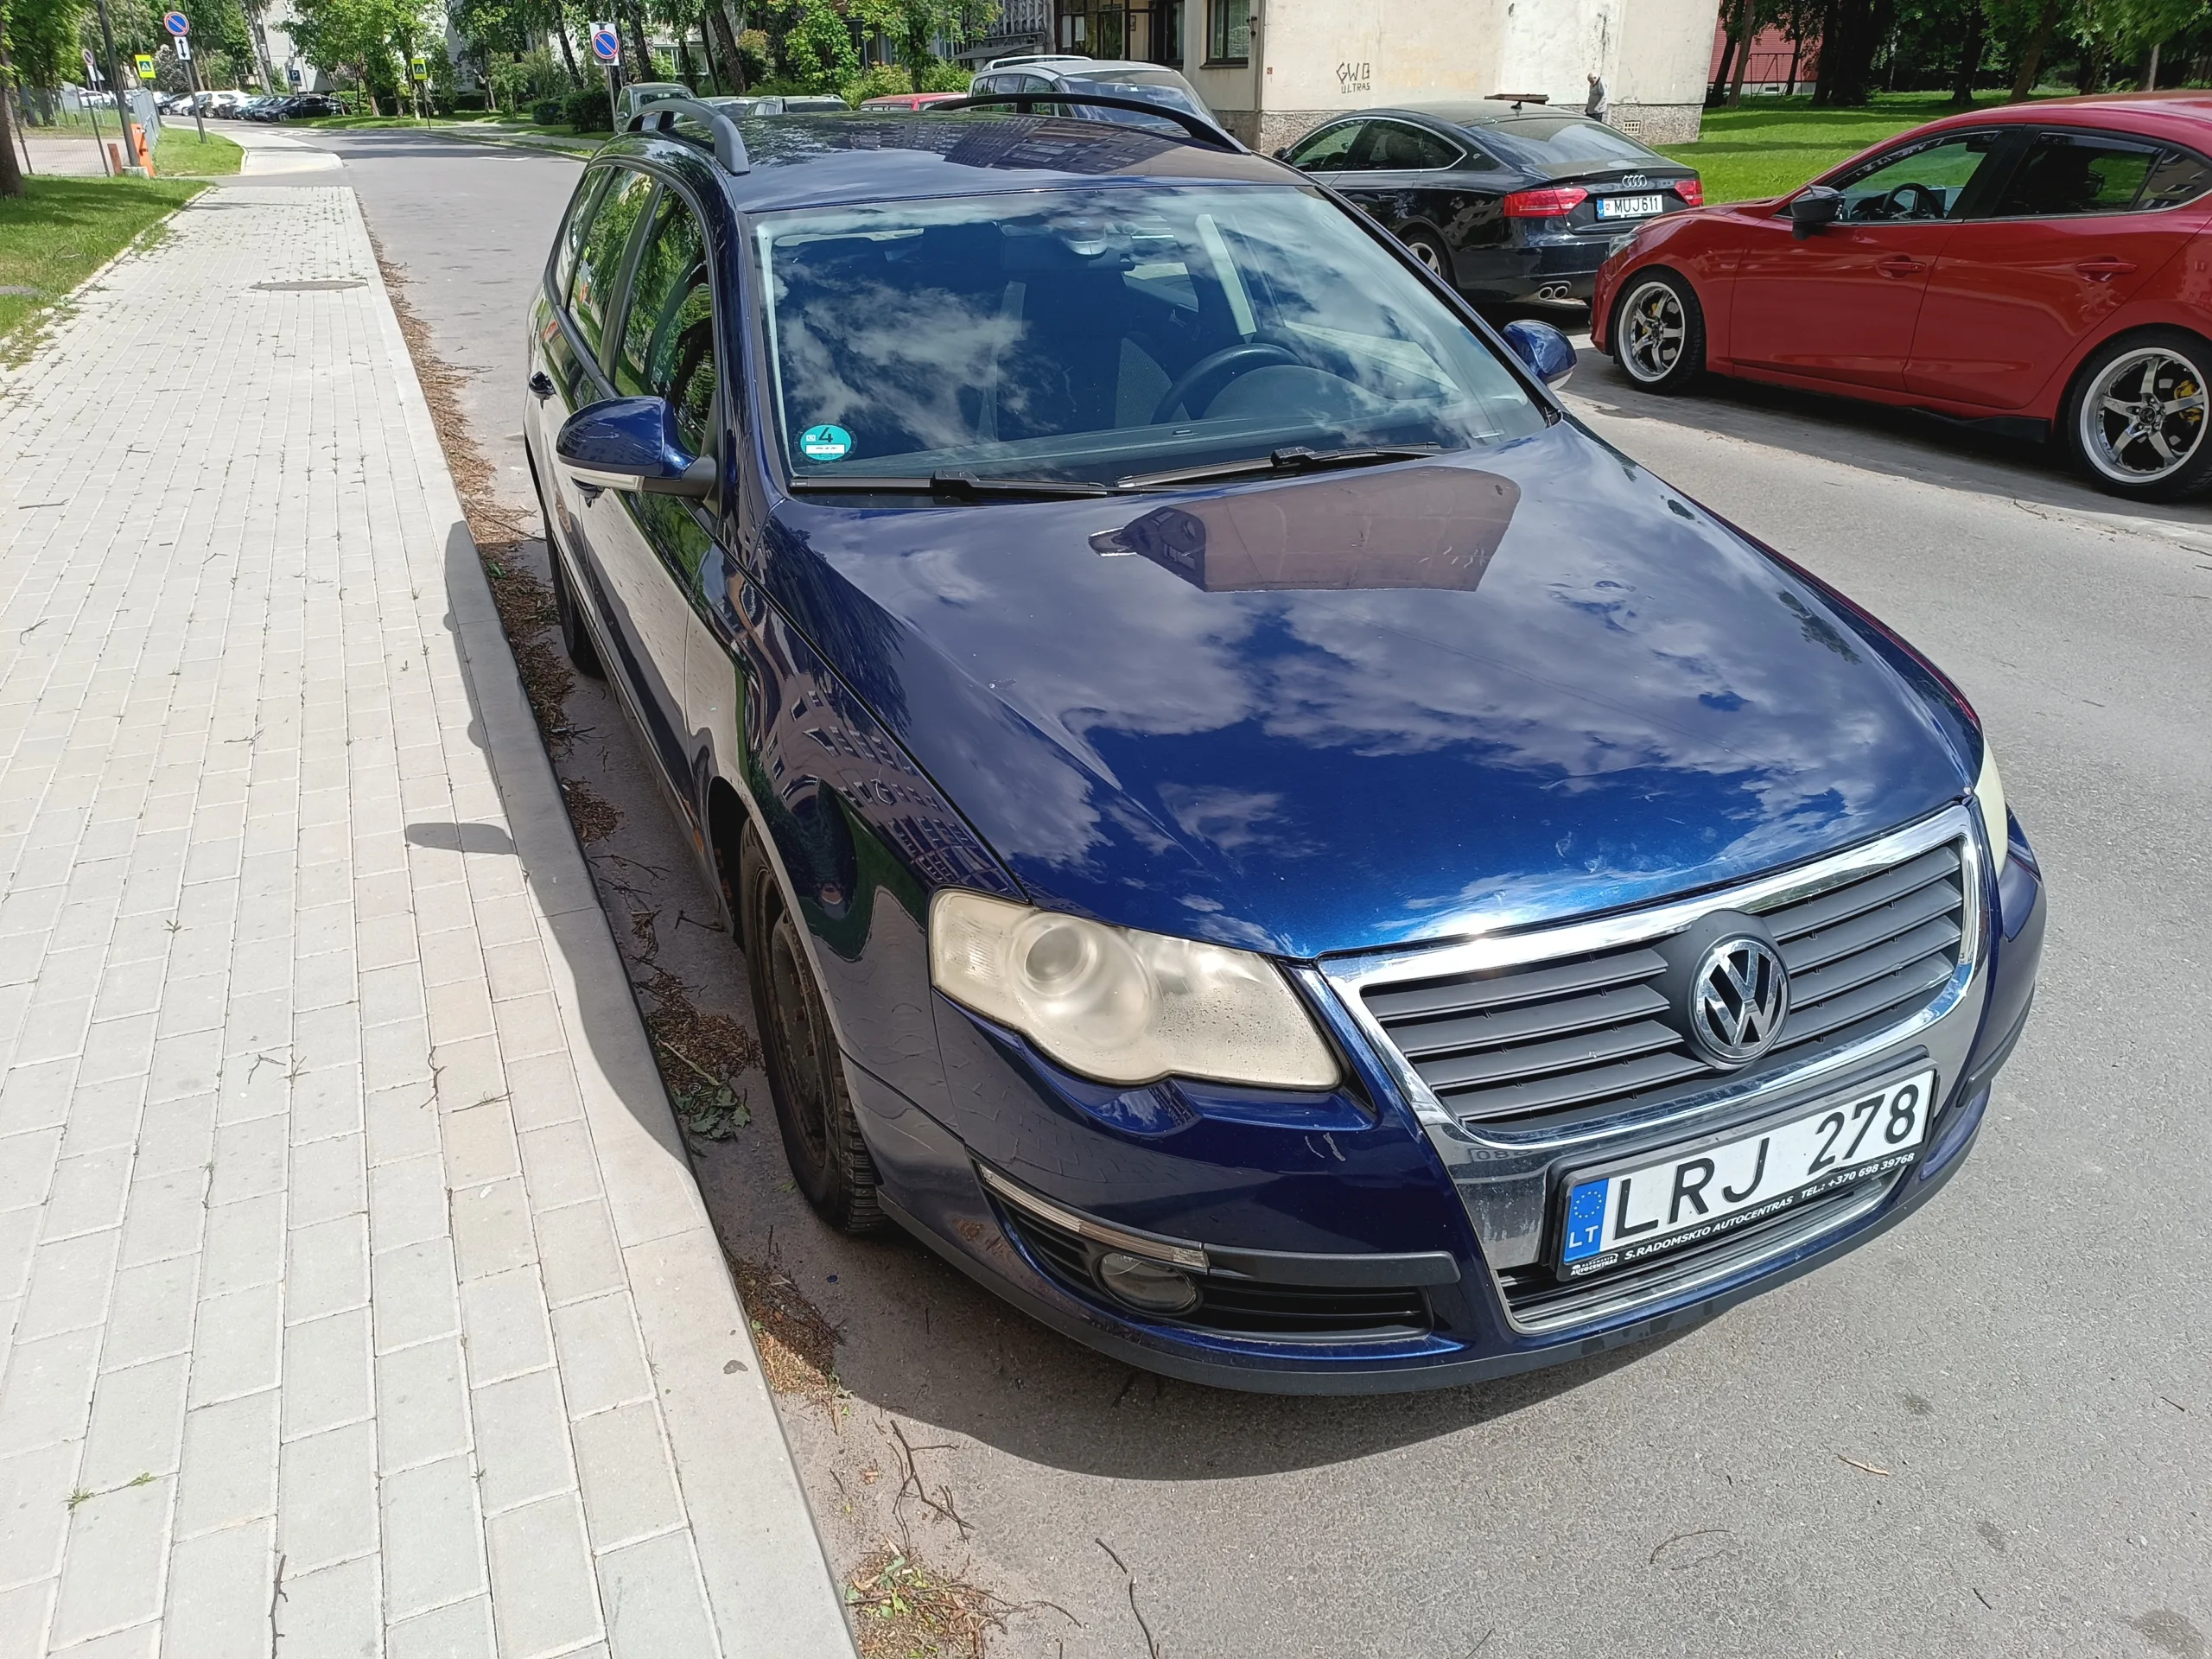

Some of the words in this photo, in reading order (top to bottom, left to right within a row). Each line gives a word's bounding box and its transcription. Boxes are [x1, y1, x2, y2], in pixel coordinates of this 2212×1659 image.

[1341, 82, 1370, 94] ULTRAS
[1613, 196, 1658, 213] MUJ611
[818, 427, 834, 443] 4
[1612, 1137, 1769, 1241] LRJ
[1807, 1084, 1919, 1177] 278
[1624, 1224, 1712, 1261] S.RADOMSKIO
[1712, 1195, 1794, 1233] AUTOCENTRAS
[1800, 1182, 1826, 1199] TEL.:
[1827, 1170, 1857, 1189] +370
[1858, 1162, 1879, 1178] 698
[1879, 1152, 1916, 1172] 39768
[1568, 1224, 1599, 1249] LT
